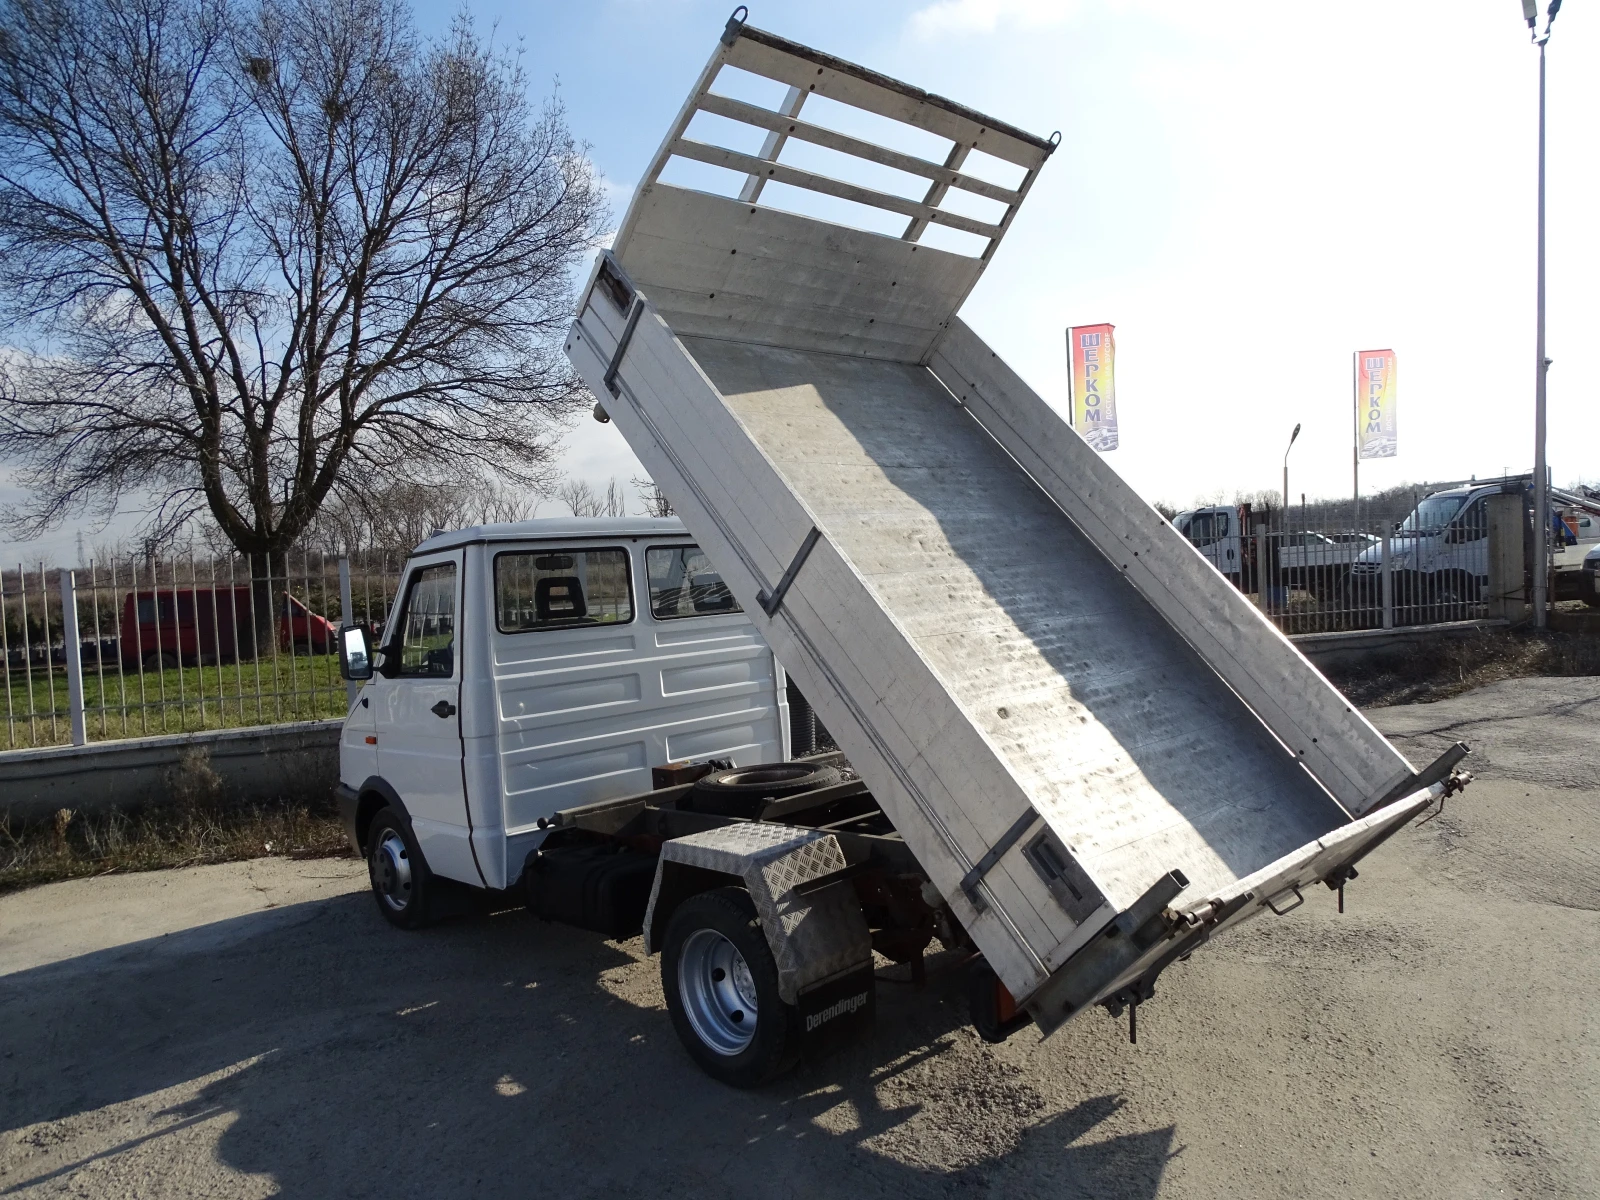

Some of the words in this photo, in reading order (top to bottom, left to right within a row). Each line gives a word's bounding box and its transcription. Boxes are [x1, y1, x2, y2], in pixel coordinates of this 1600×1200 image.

[1081, 333, 1101, 422] ШЕРКОМ
[1366, 357, 1385, 433] ШЕРКОМ
[806, 991, 868, 1032] Derendinger
